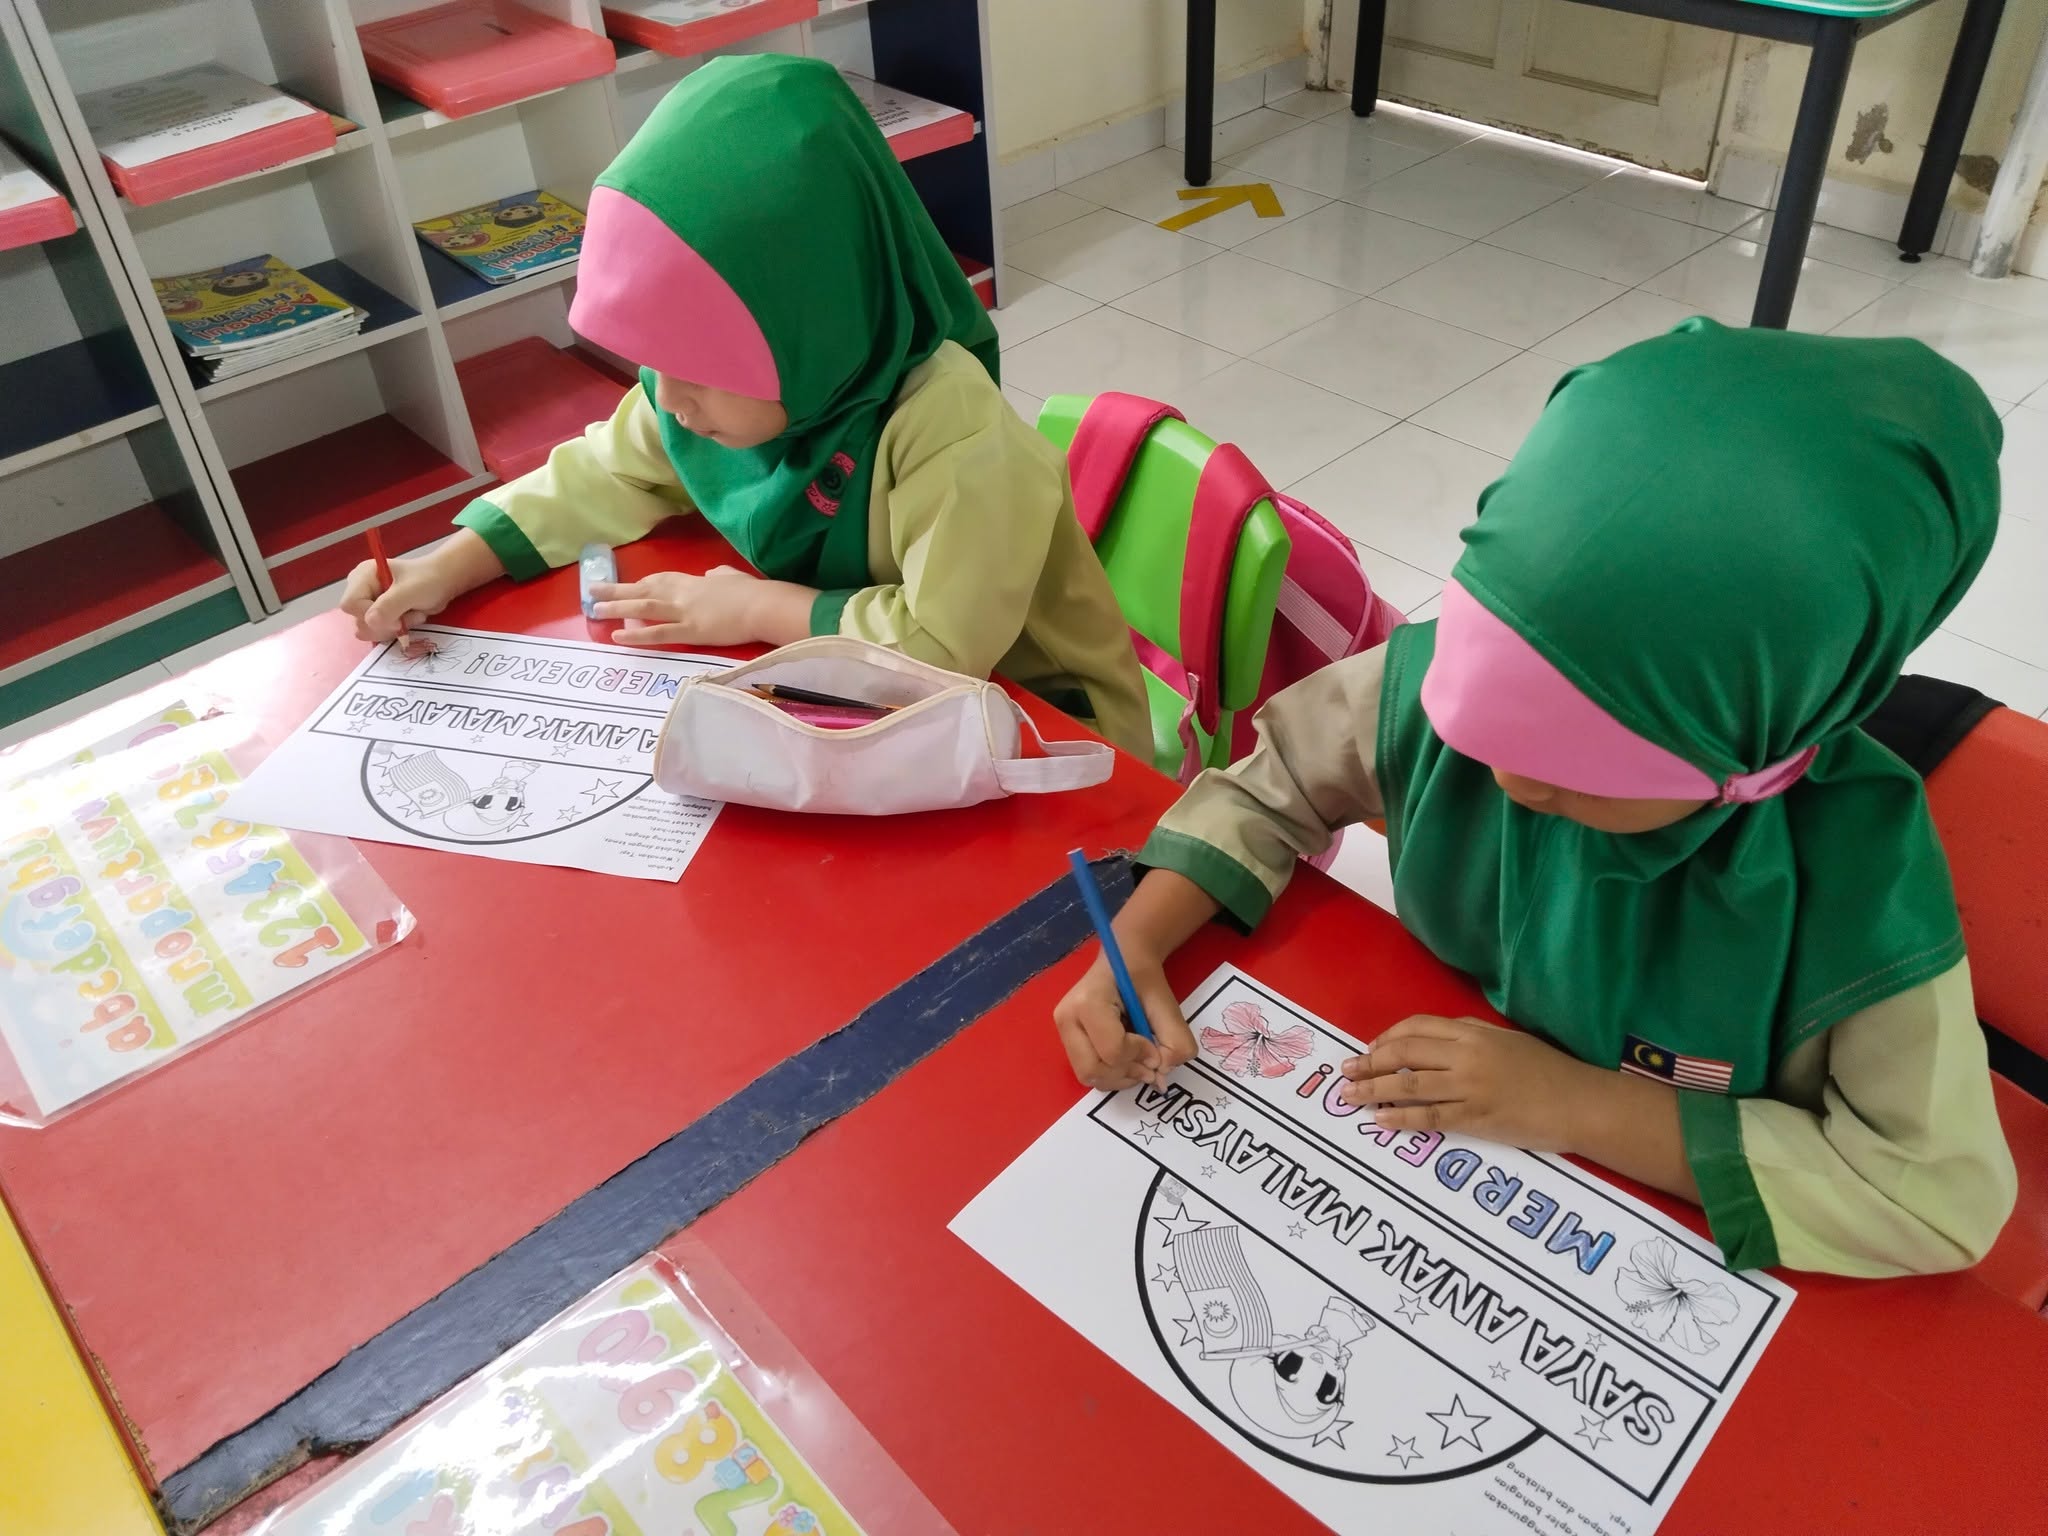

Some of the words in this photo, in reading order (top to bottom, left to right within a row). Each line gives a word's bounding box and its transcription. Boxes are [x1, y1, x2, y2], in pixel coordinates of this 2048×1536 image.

[478, 224, 568, 260] Husna
[182, 293, 291, 330] Husna
[194, 293, 319, 340] Asmaul
[464, 652, 690, 699] MERDEKA!
[344, 692, 529, 736] MALAYSIA
[523, 715, 641, 749] ANAK
[1135, 1082, 1372, 1246] MALAYSIA
[1360, 1219, 1528, 1344] ANAK
[1521, 1318, 1674, 1446] SAYA
[1494, 1476, 1543, 1516] bahagian
[1506, 1461, 1553, 1501] belakang
[1555, 1498, 1575, 1515] dan
